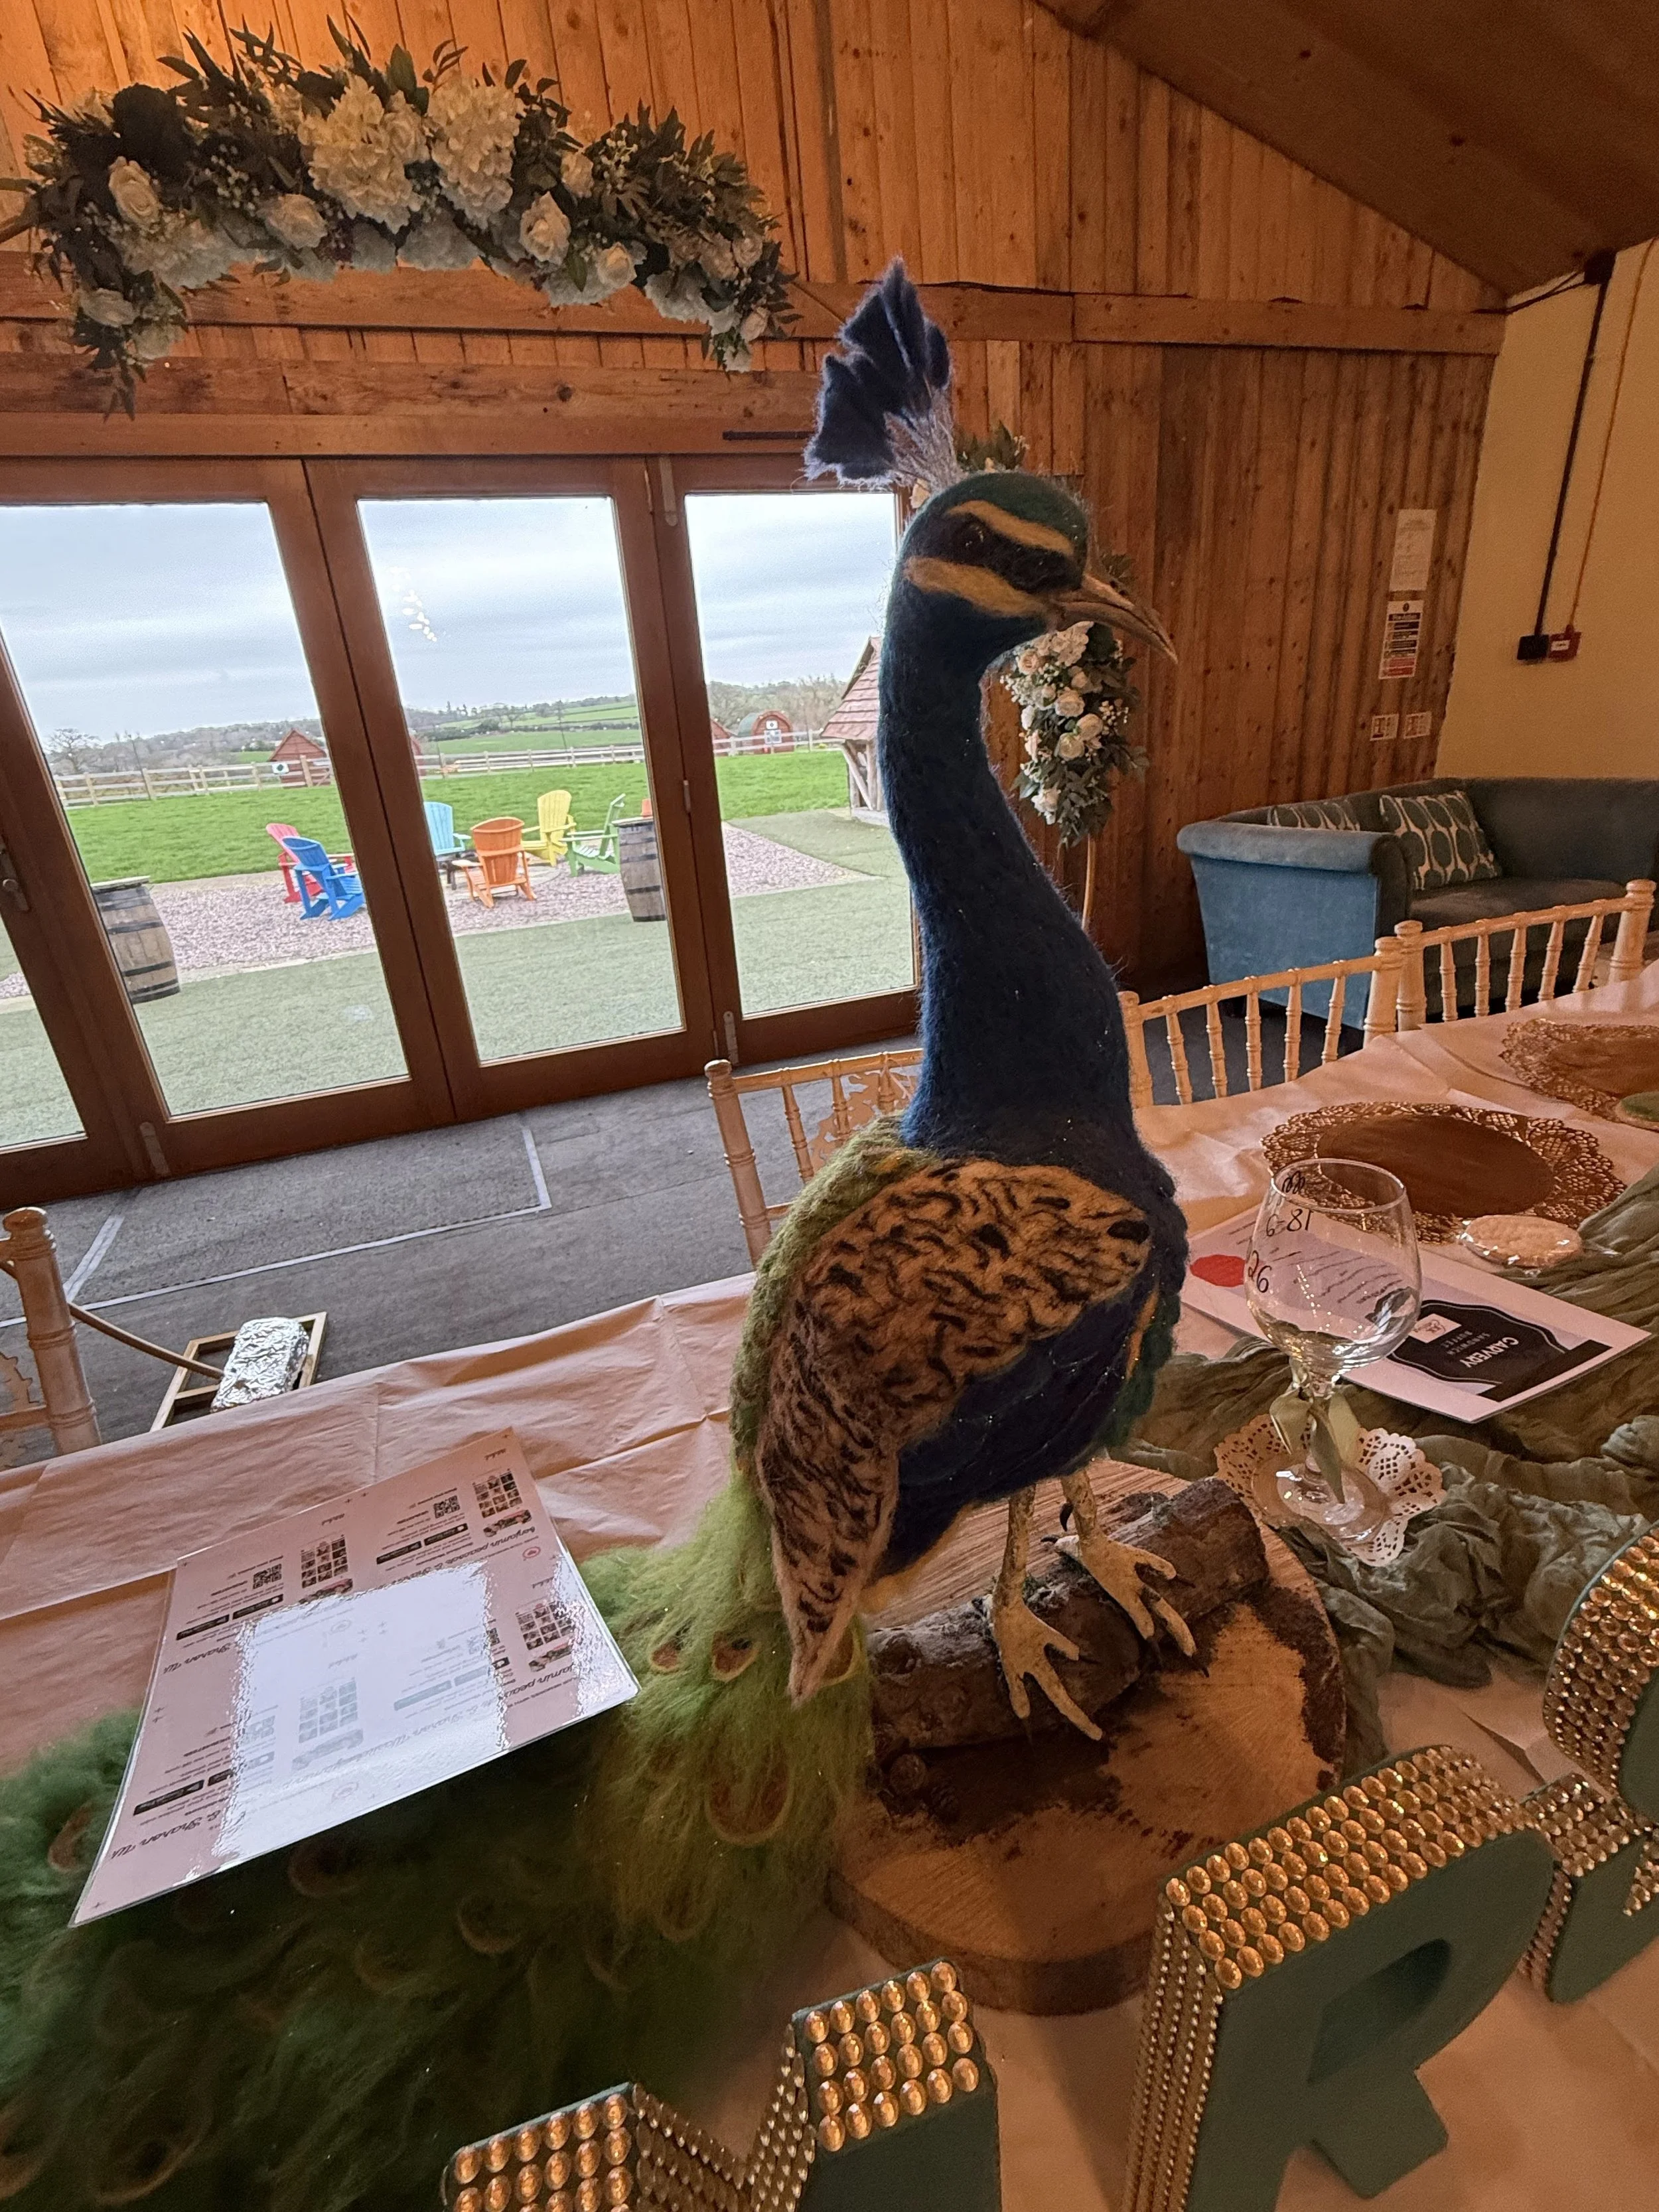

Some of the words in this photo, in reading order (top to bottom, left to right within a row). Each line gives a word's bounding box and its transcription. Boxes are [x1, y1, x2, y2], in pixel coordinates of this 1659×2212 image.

[1459, 1337, 1519, 1368] CARVERY
[490, 1526, 536, 1546] benjamin
[184, 1643, 232, 1664] Sharon
[537, 1662, 574, 1684] jamin
[207, 1810, 222, 1822] &
[140, 1815, 203, 1846] Sharon
